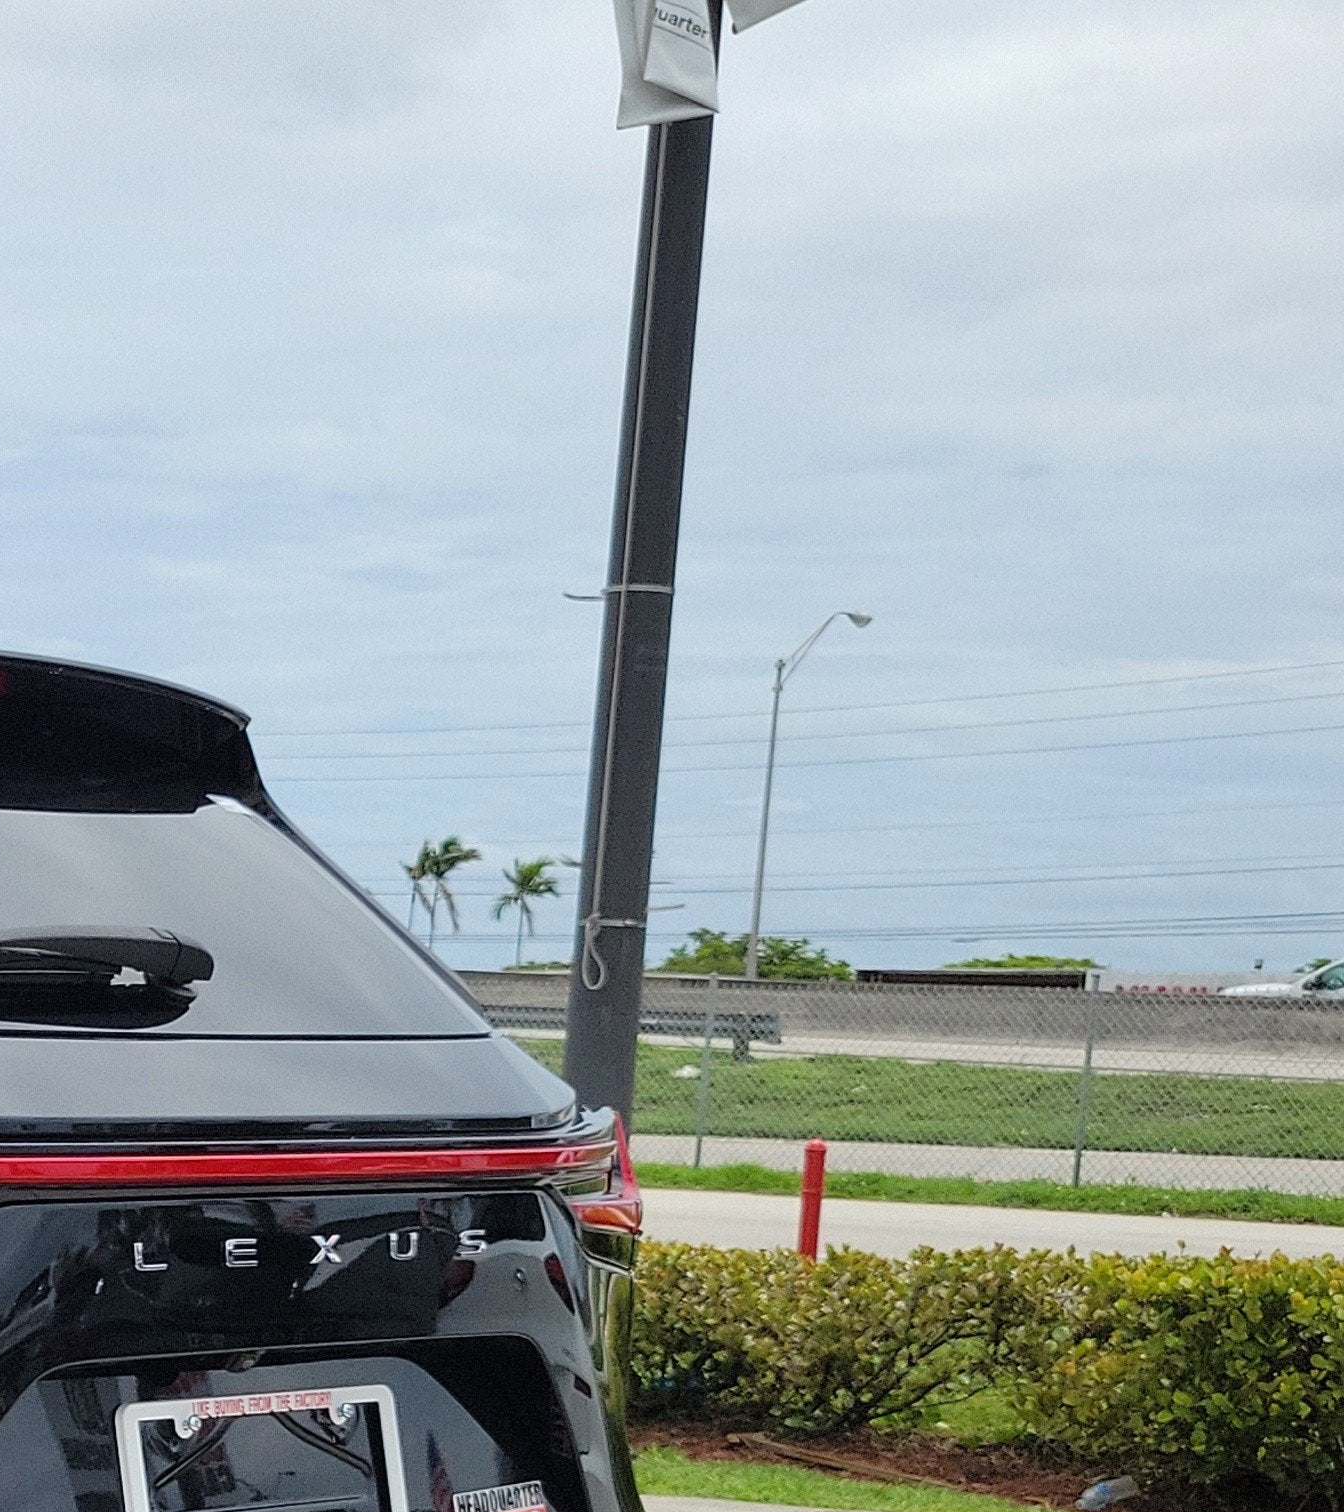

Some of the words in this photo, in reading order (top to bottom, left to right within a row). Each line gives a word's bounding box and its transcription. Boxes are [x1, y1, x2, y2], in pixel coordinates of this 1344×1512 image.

[133, 1228, 489, 1272] LEXUS
[249, 1397, 272, 1411] FROM
[275, 1395, 291, 1408] THE
